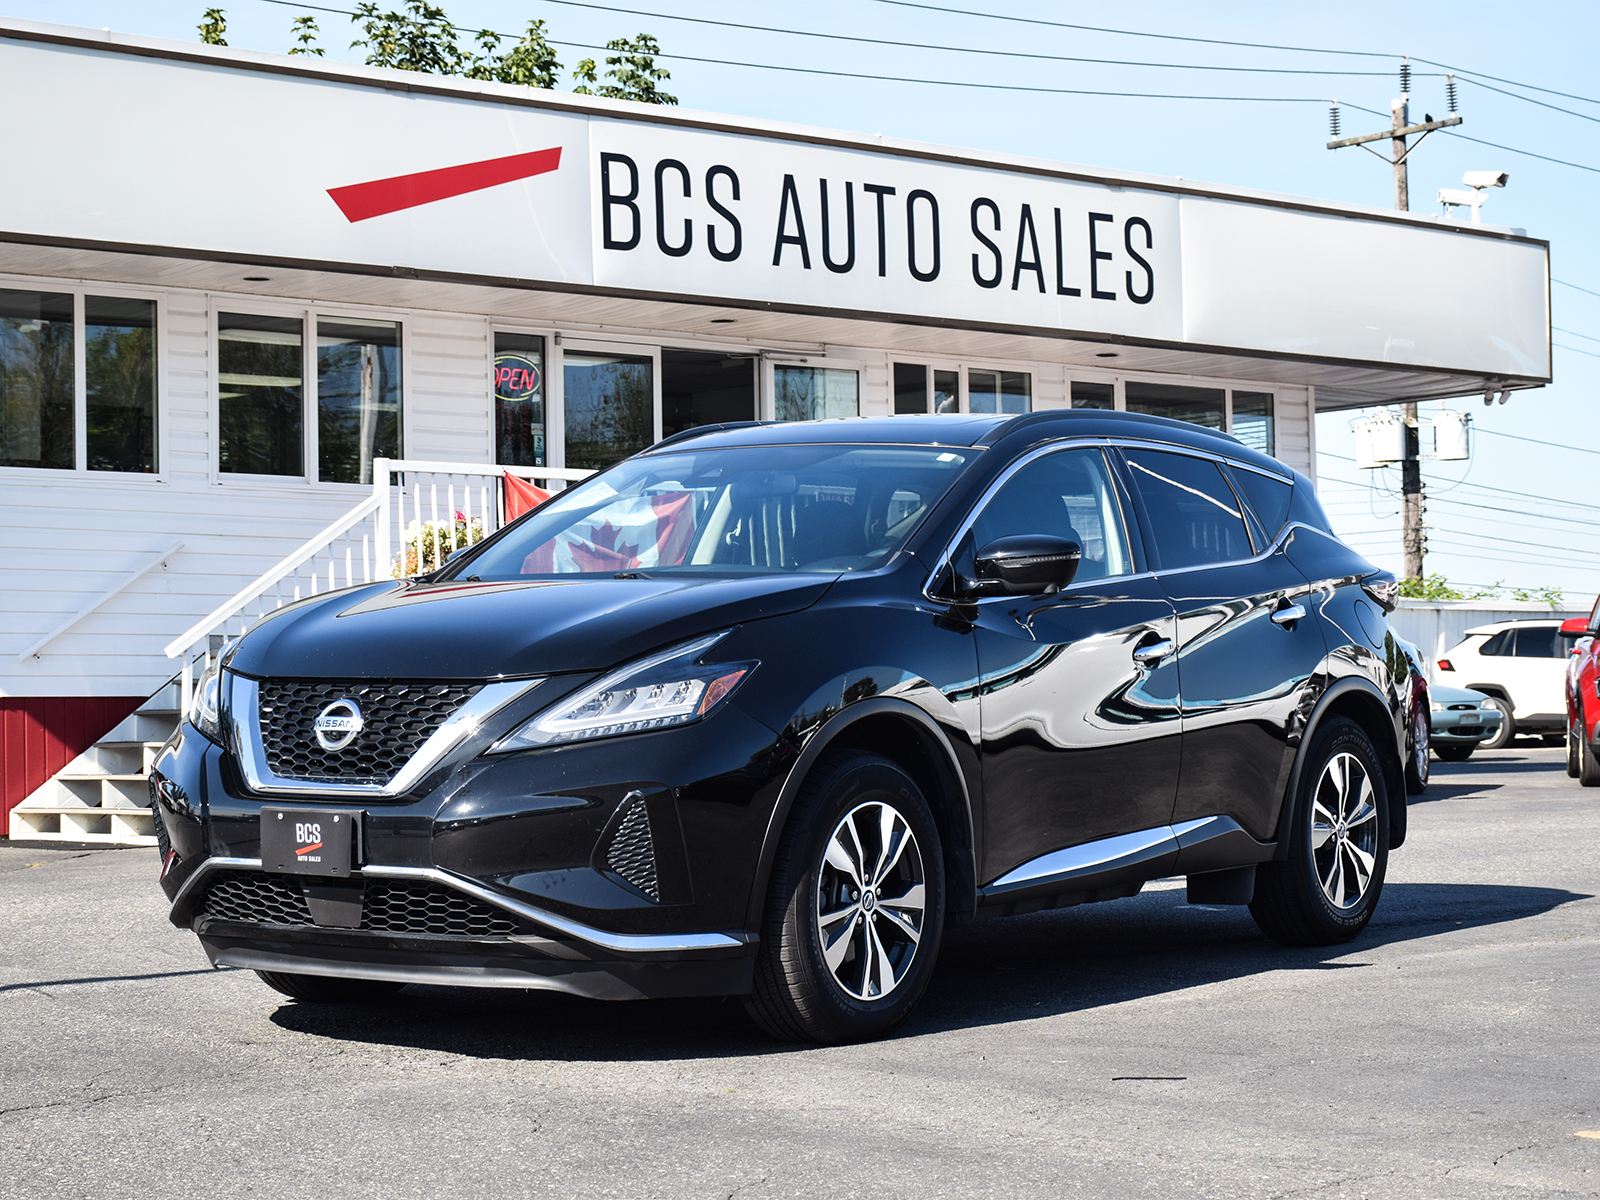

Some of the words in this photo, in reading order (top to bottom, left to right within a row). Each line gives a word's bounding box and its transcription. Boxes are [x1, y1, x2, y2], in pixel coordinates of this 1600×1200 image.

[599, 151, 743, 262] BCS
[772, 174, 942, 283] AUTO
[970, 197, 1154, 305] SALES
[316, 719, 354, 729] NISSAN
[295, 822, 322, 844] BCS
